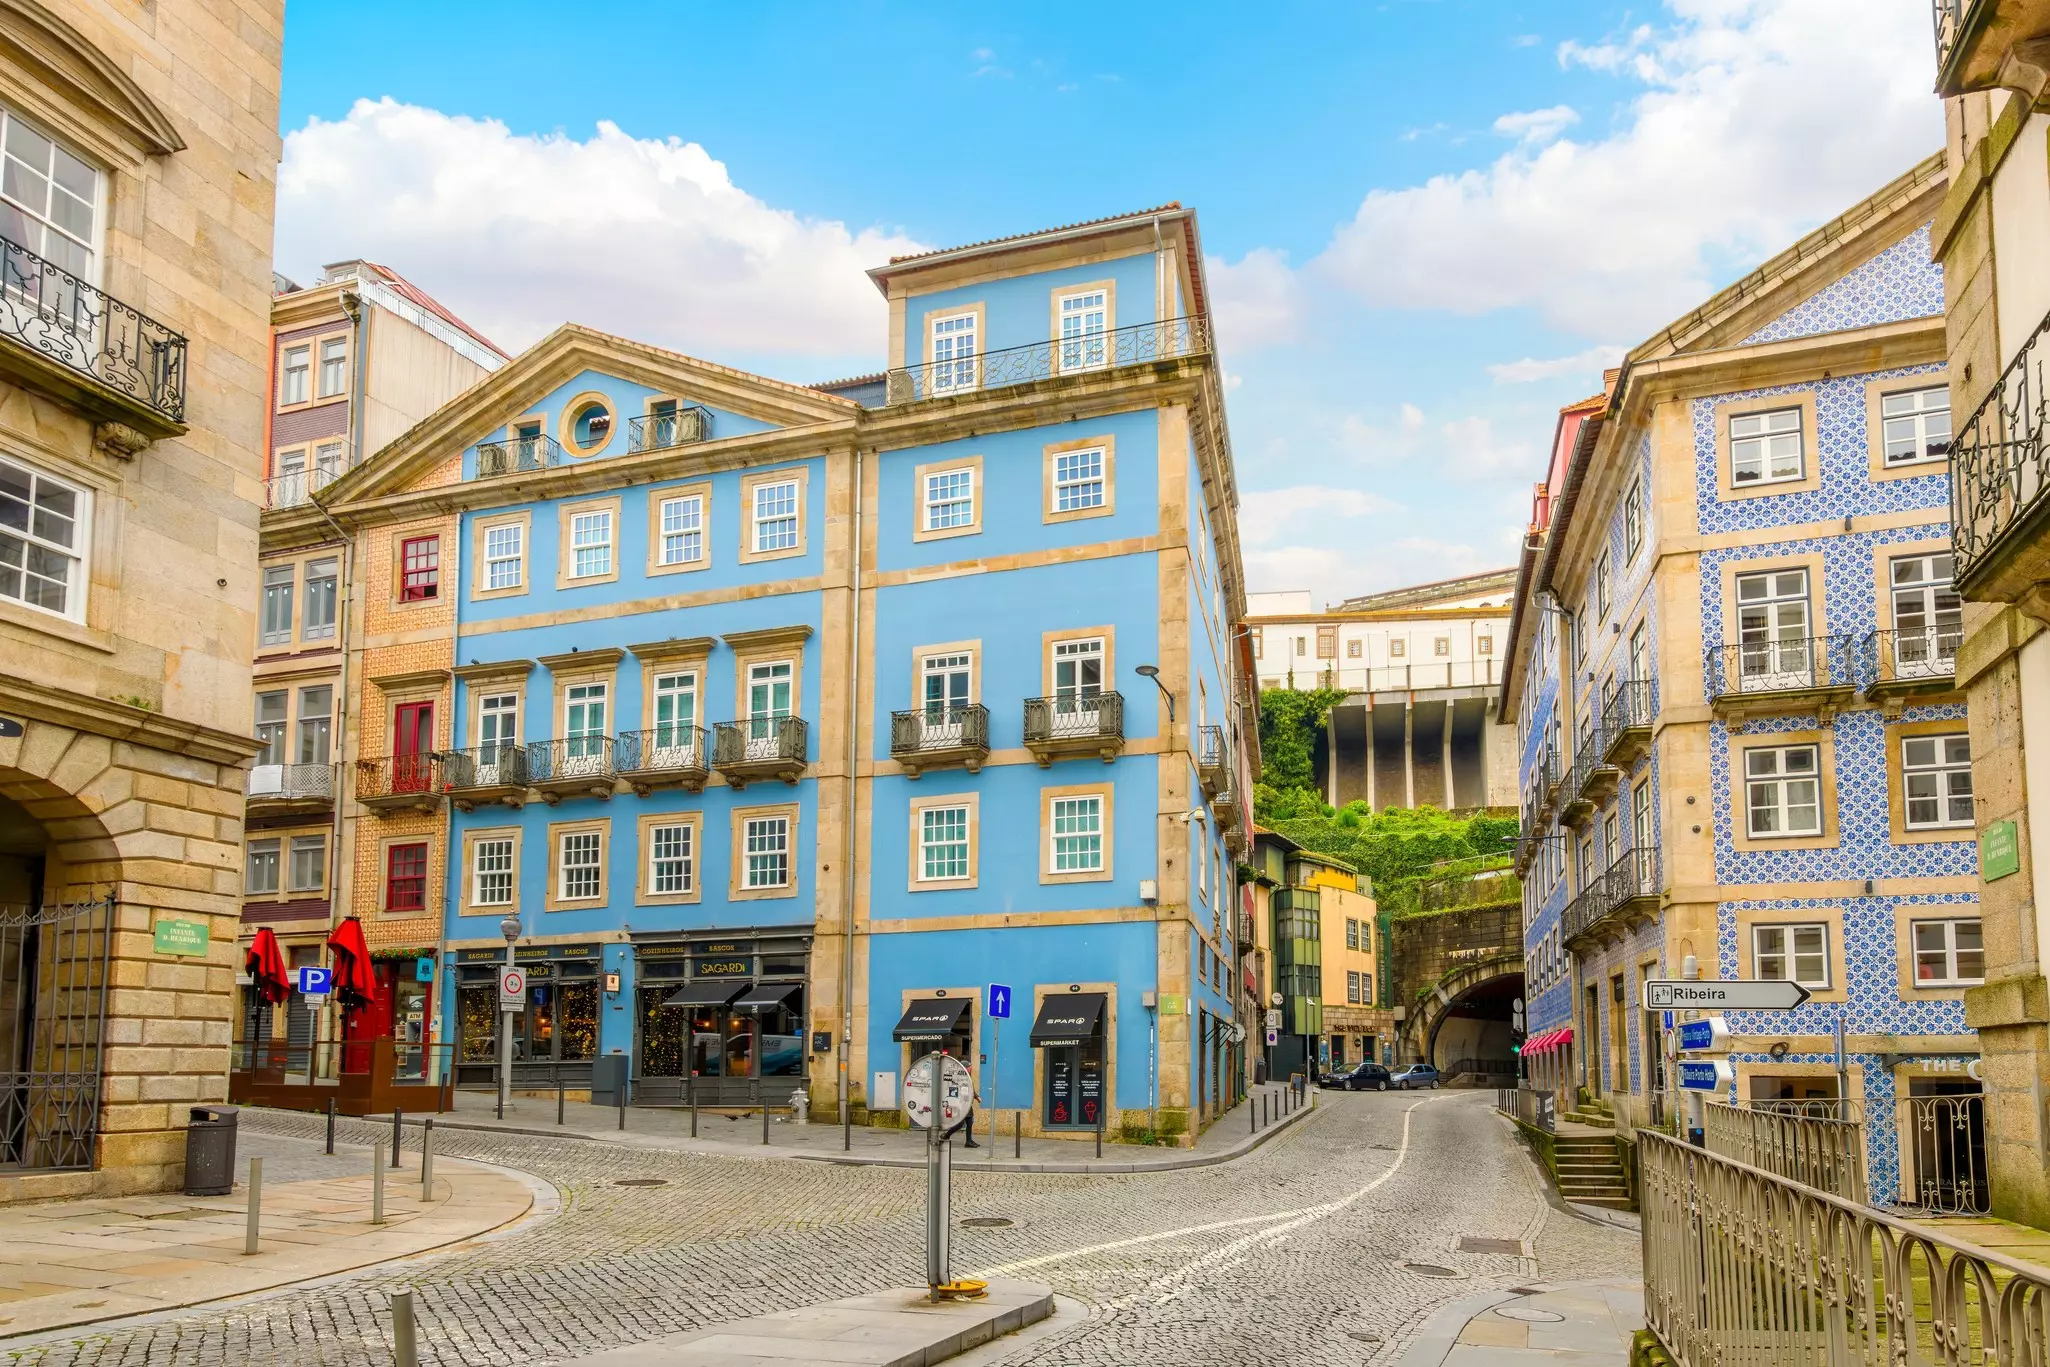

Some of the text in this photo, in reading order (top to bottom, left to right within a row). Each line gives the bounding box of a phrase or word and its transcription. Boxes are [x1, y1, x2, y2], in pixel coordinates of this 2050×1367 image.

[170, 927, 196, 937] INFANTE
[170, 935, 202, 944] HENRIQUE
[641, 946, 684, 955] COZINHEIROS
[708, 944, 735, 952] BASCOS
[701, 962, 746, 974] SAGARDI
[306, 969, 325, 991] P
[1673, 988, 1726, 1000] Ribeira
[1920, 1060, 1961, 1072] THE
[1695, 1067, 1705, 1081] Porto
[1705, 1068, 1715, 1082] Hotel
